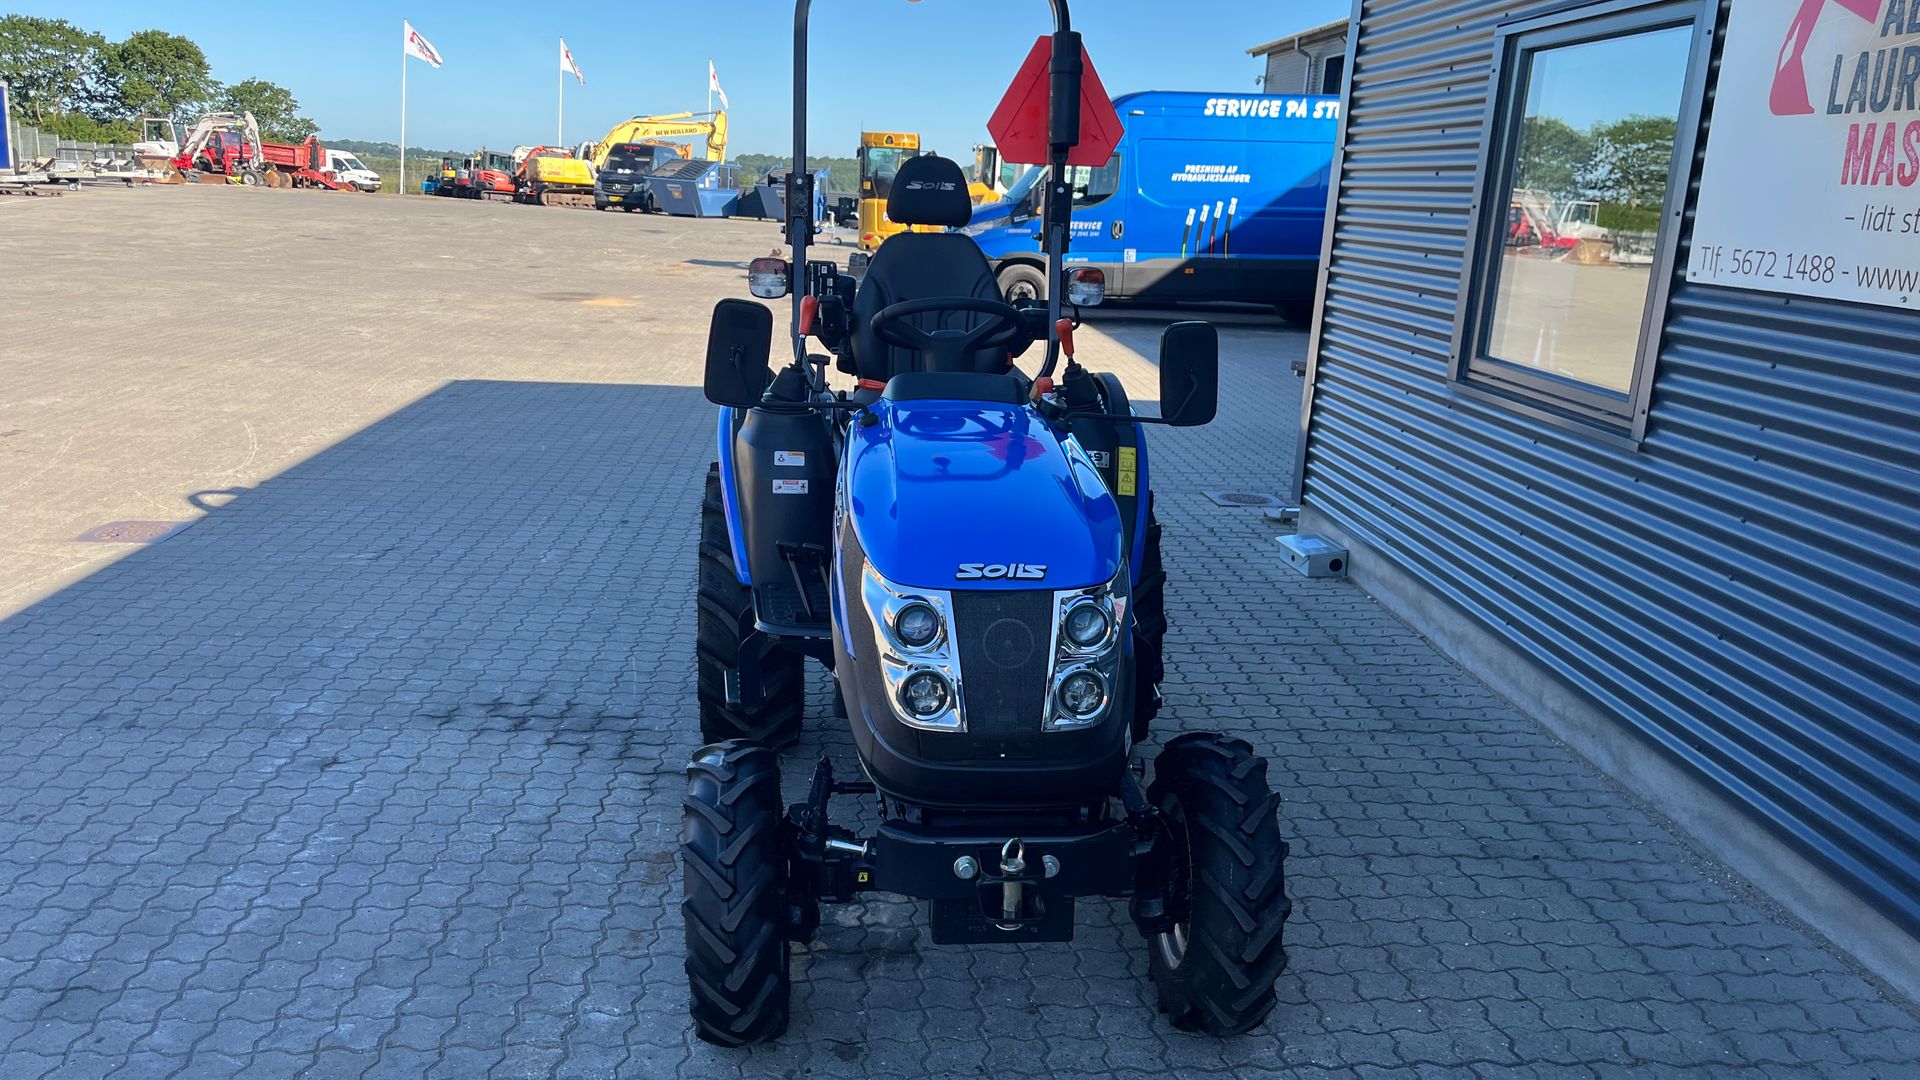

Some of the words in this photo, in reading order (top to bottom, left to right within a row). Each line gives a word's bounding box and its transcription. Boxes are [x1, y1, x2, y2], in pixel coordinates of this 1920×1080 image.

[1203, 98, 1283, 118] SERVICE
[1285, 97, 1307, 118] PÅ
[670, 127, 697, 135] HOLLAND
[1840, 120, 1920, 187] MAS
[1226, 165, 1238, 174] AF
[1861, 203, 1896, 232] lidt
[1701, 246, 1724, 278] Tlf.
[1730, 248, 1777, 278] 5672
[1783, 252, 1836, 283] 1488
[956, 563, 1047, 579] SOLIS
